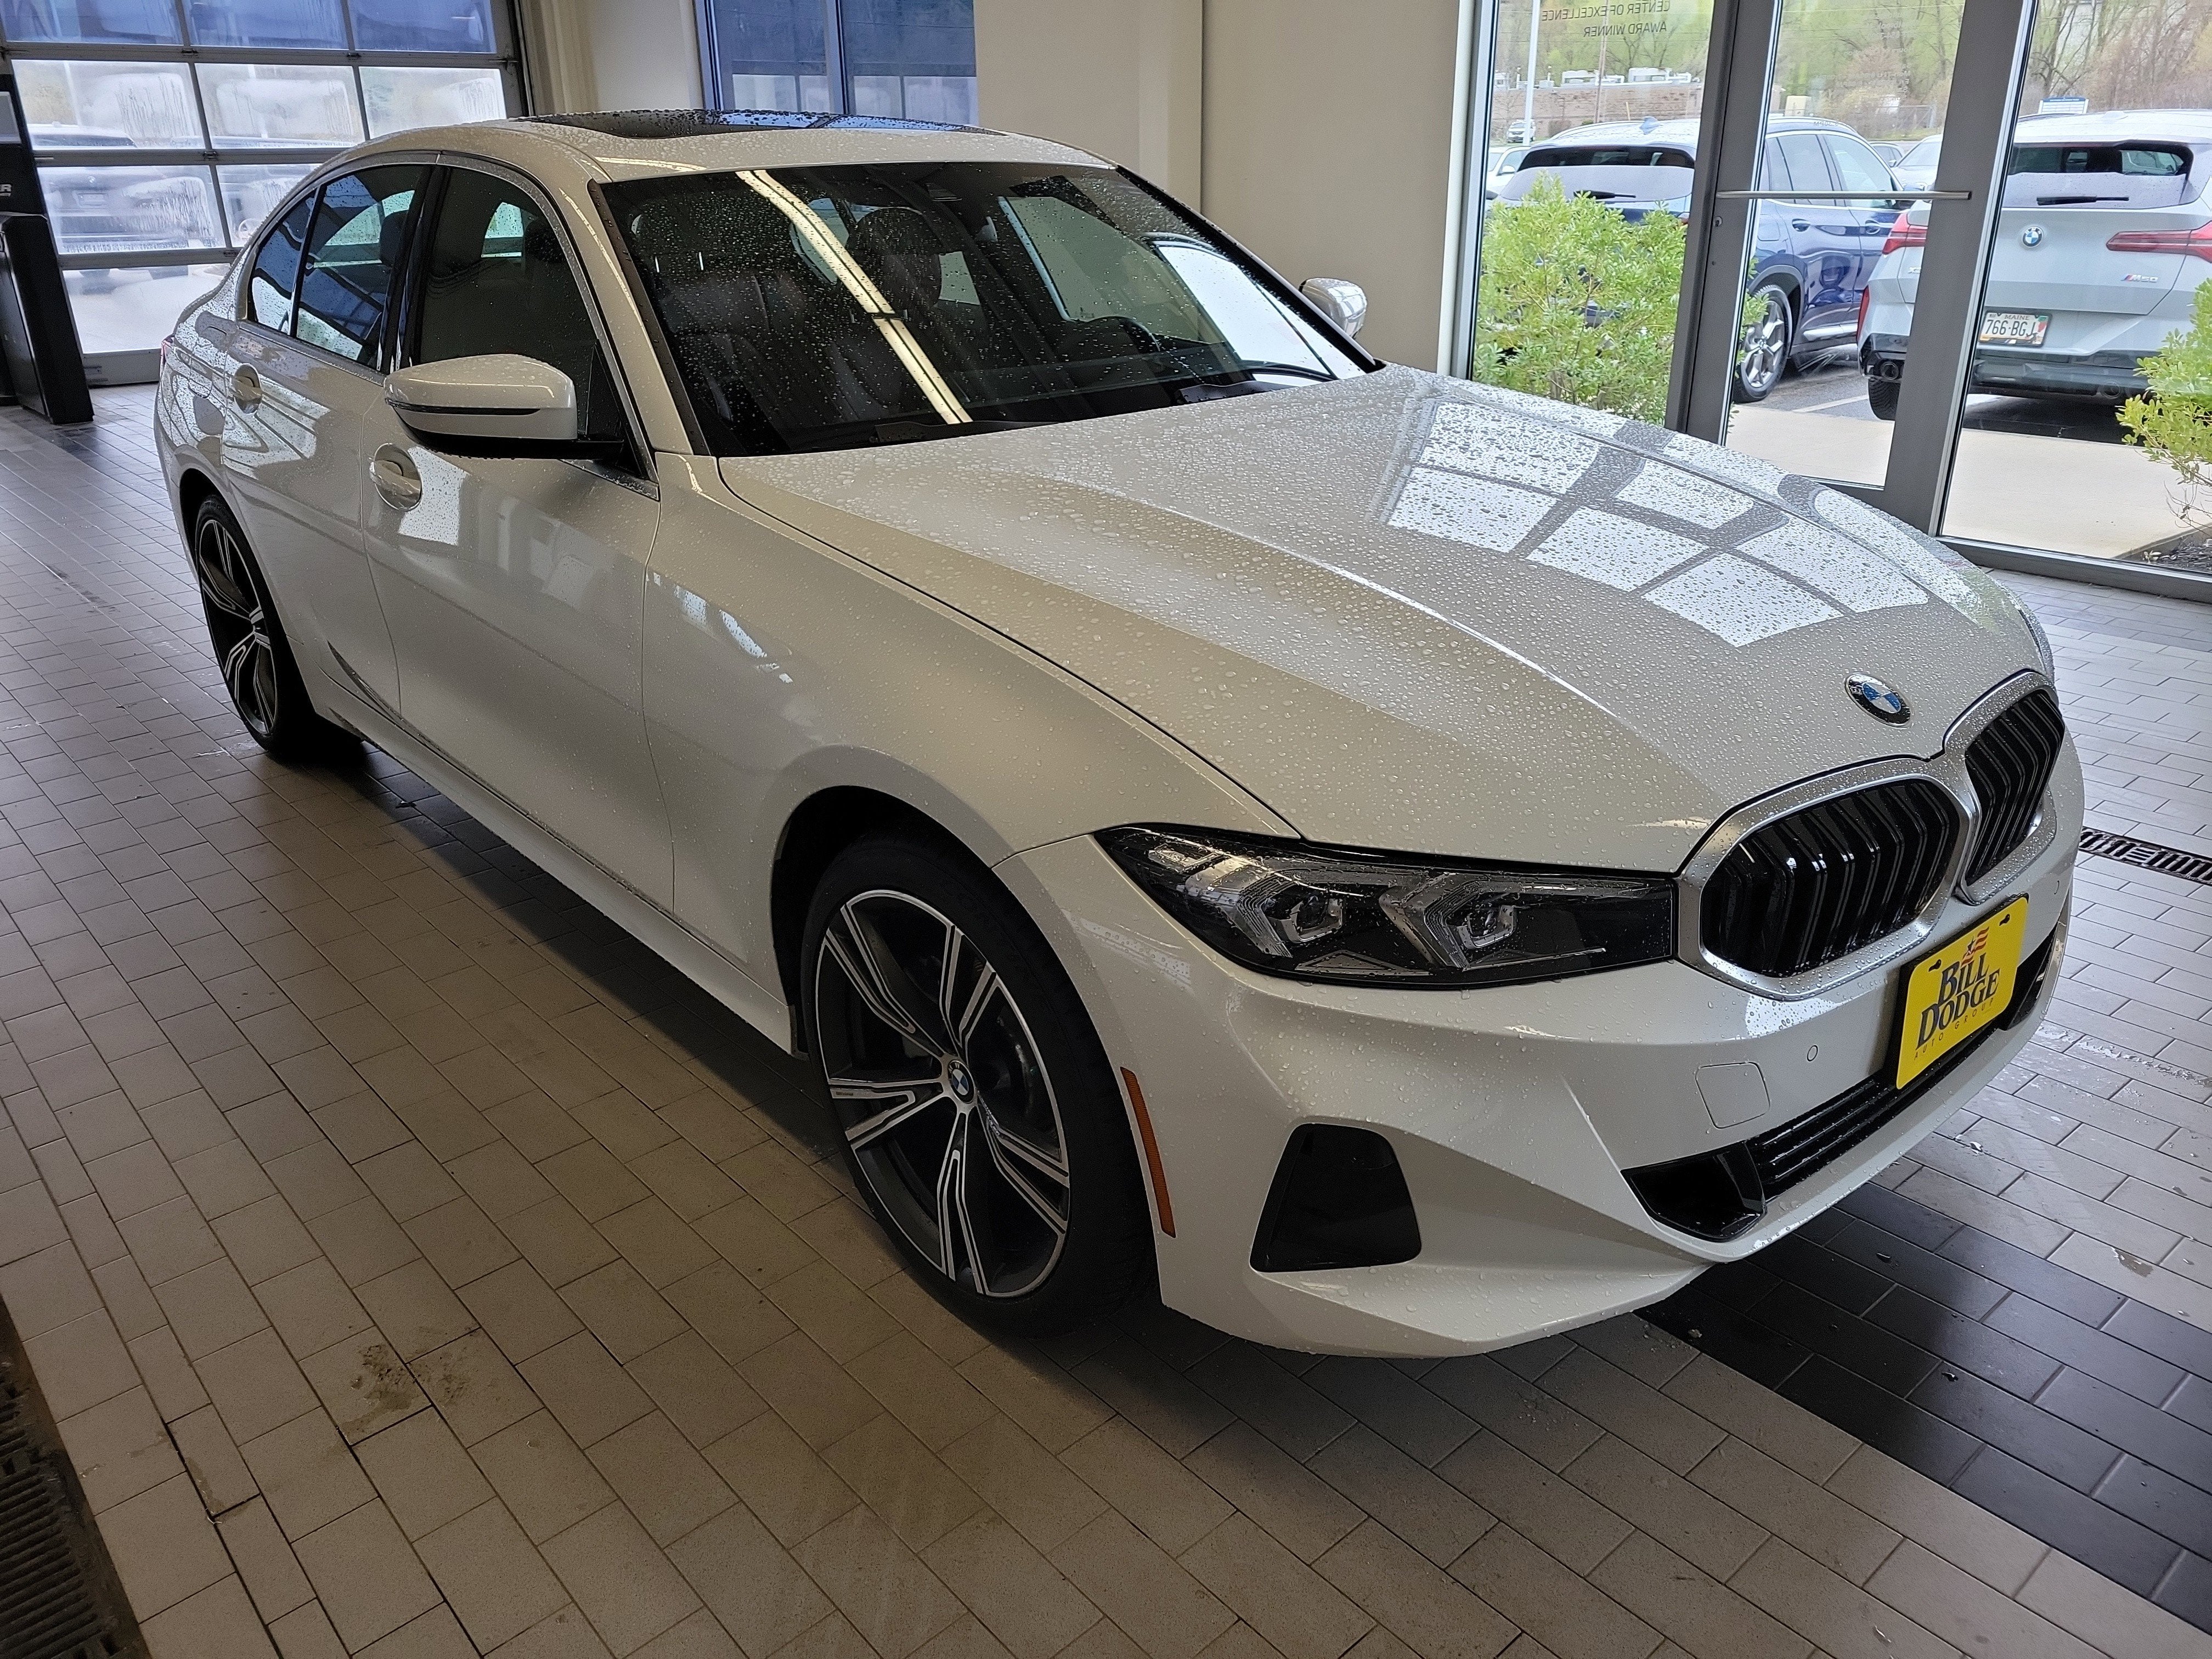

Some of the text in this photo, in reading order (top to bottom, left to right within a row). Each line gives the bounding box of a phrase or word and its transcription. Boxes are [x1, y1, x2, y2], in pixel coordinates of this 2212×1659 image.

[2130, 274, 2158, 283] M50
[1938, 952, 1990, 1006] BILL
[1914, 997, 1994, 1060] AUTO GROUP
[1915, 968, 2000, 1051] DODGE
